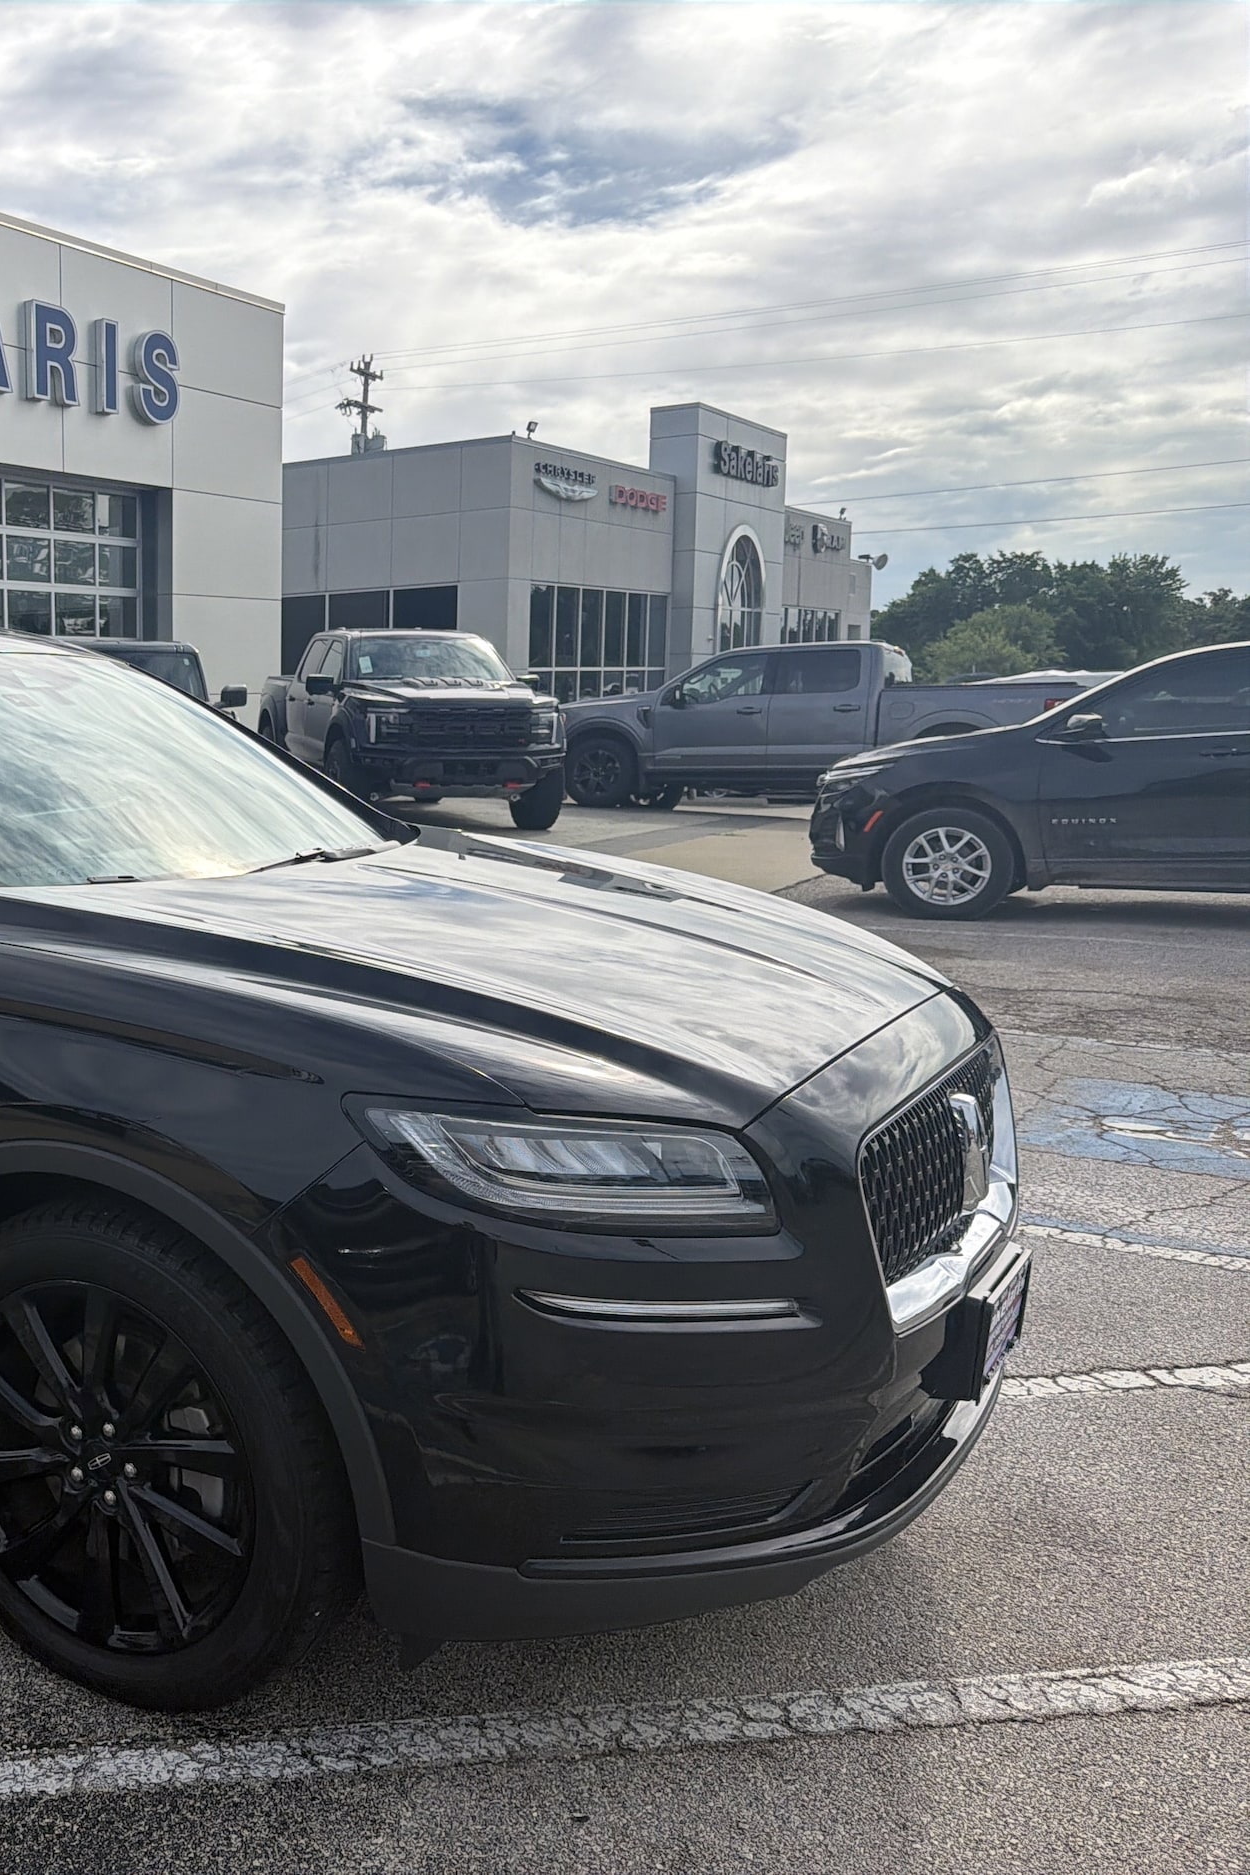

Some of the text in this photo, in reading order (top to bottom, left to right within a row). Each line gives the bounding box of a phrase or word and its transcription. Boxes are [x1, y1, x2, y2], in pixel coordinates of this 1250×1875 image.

[534, 462, 596, 484] CHRYSLER
[717, 440, 779, 487] Sakelaris
[611, 485, 667, 514] DODGE
